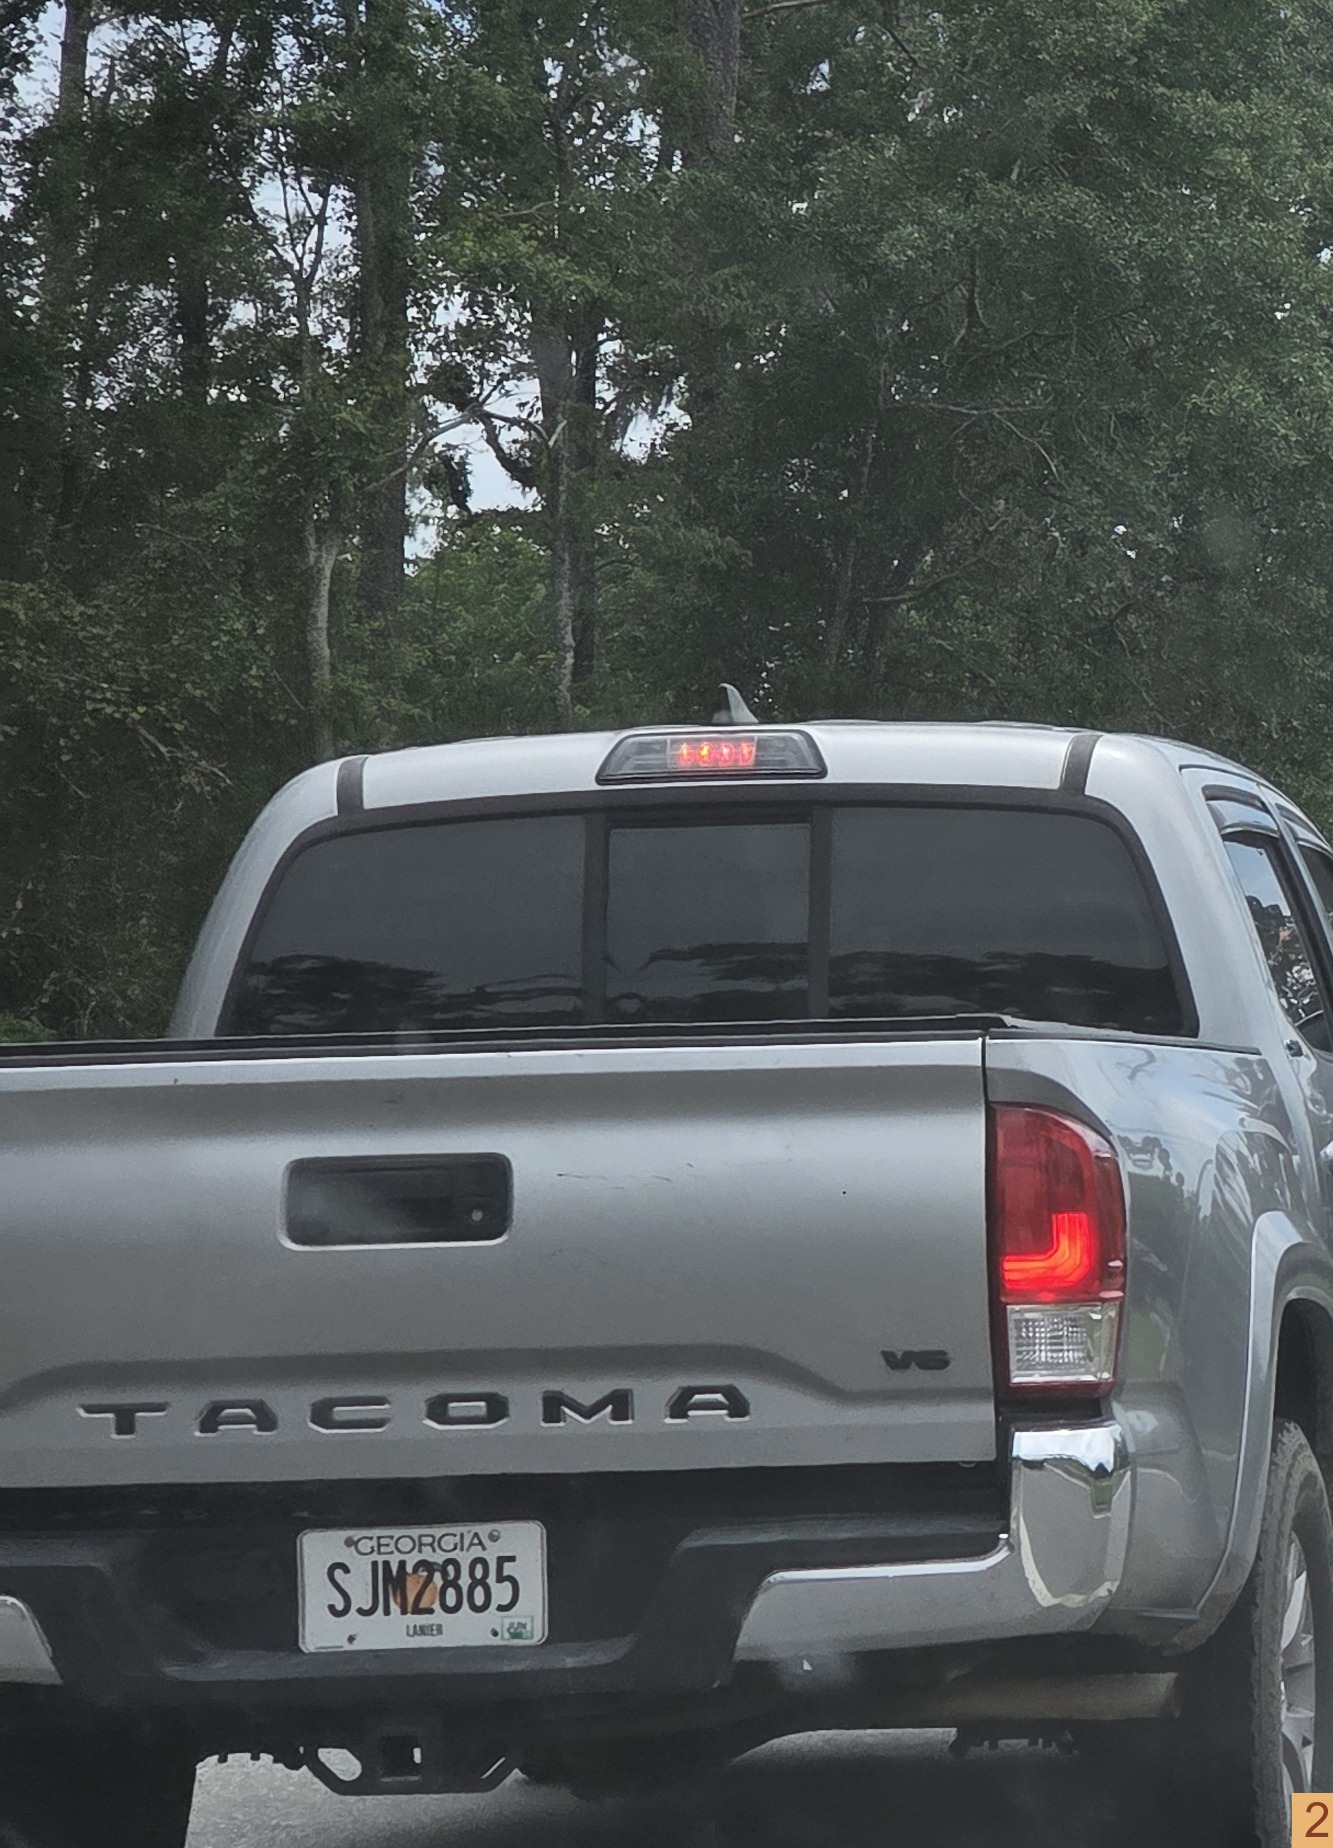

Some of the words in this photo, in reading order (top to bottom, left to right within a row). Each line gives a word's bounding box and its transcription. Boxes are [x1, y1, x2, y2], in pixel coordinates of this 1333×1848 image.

[880, 1350, 950, 1371] V6
[76, 1384, 751, 1438] TACOMA
[353, 1531, 488, 1556] GEORGIA
[326, 1555, 520, 1618] SJM2885
